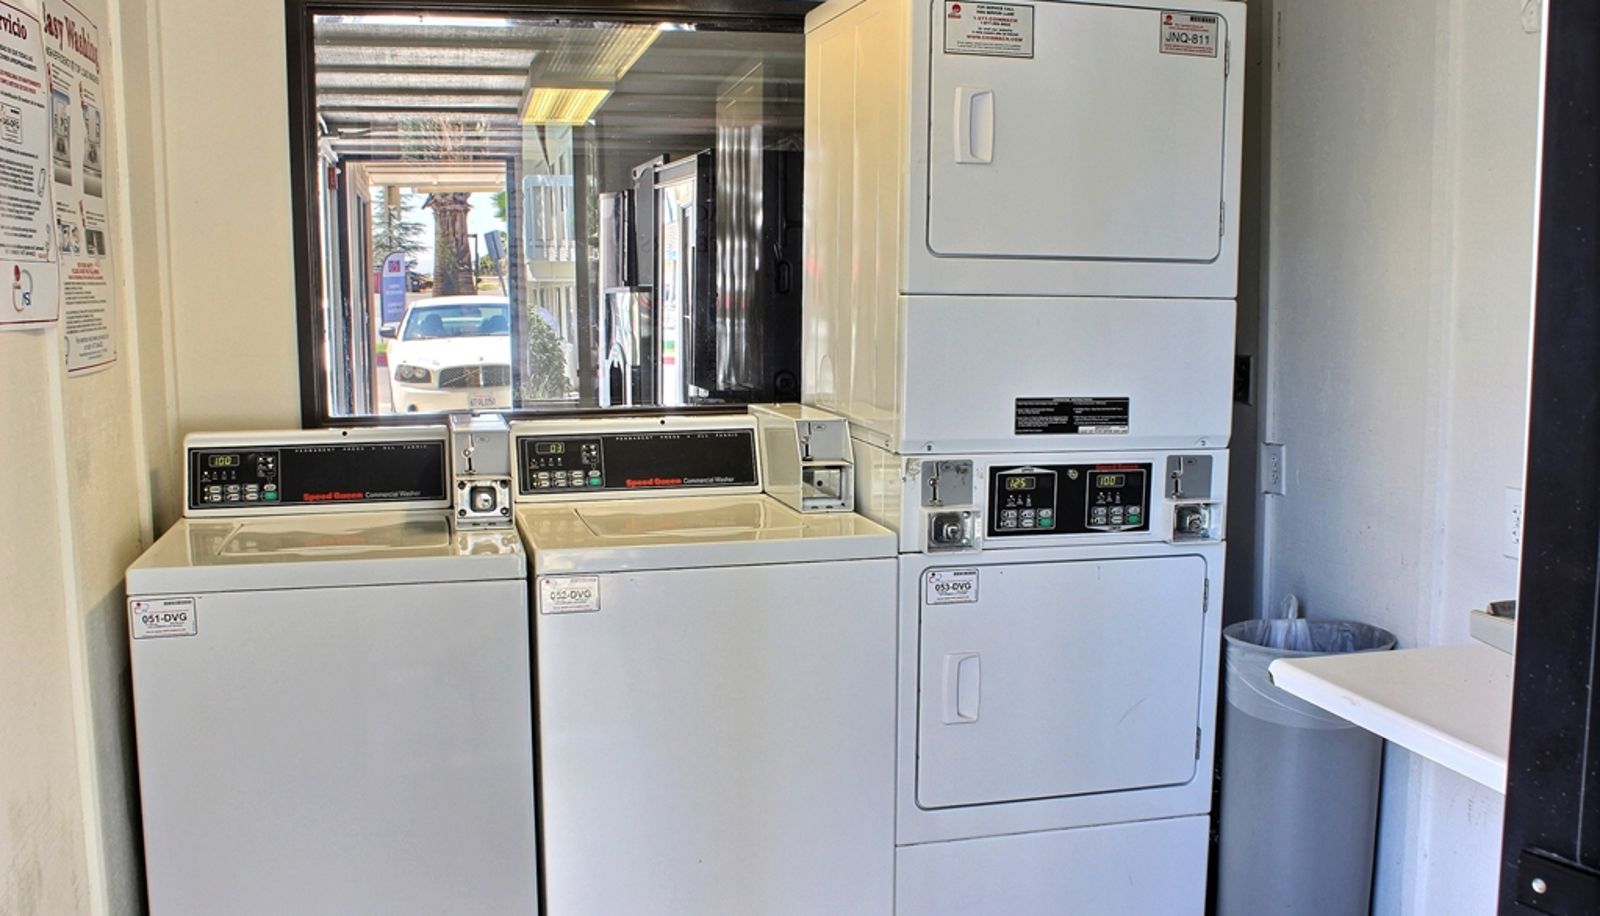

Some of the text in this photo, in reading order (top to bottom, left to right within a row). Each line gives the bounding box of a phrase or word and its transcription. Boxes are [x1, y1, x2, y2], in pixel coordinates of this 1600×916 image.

[1165, 31, 1210, 45] JNQ-811
[64, 16, 100, 74] Washing
[214, 456, 232, 466] 100
[625, 478, 654, 488] Speed
[1010, 478, 1026, 488] 125
[1100, 476, 1116, 486] 100
[303, 491, 333, 502] Speed
[334, 491, 364, 499] Queen
[399, 489, 422, 497] Washer
[142, 612, 187, 624] 051-DVG
